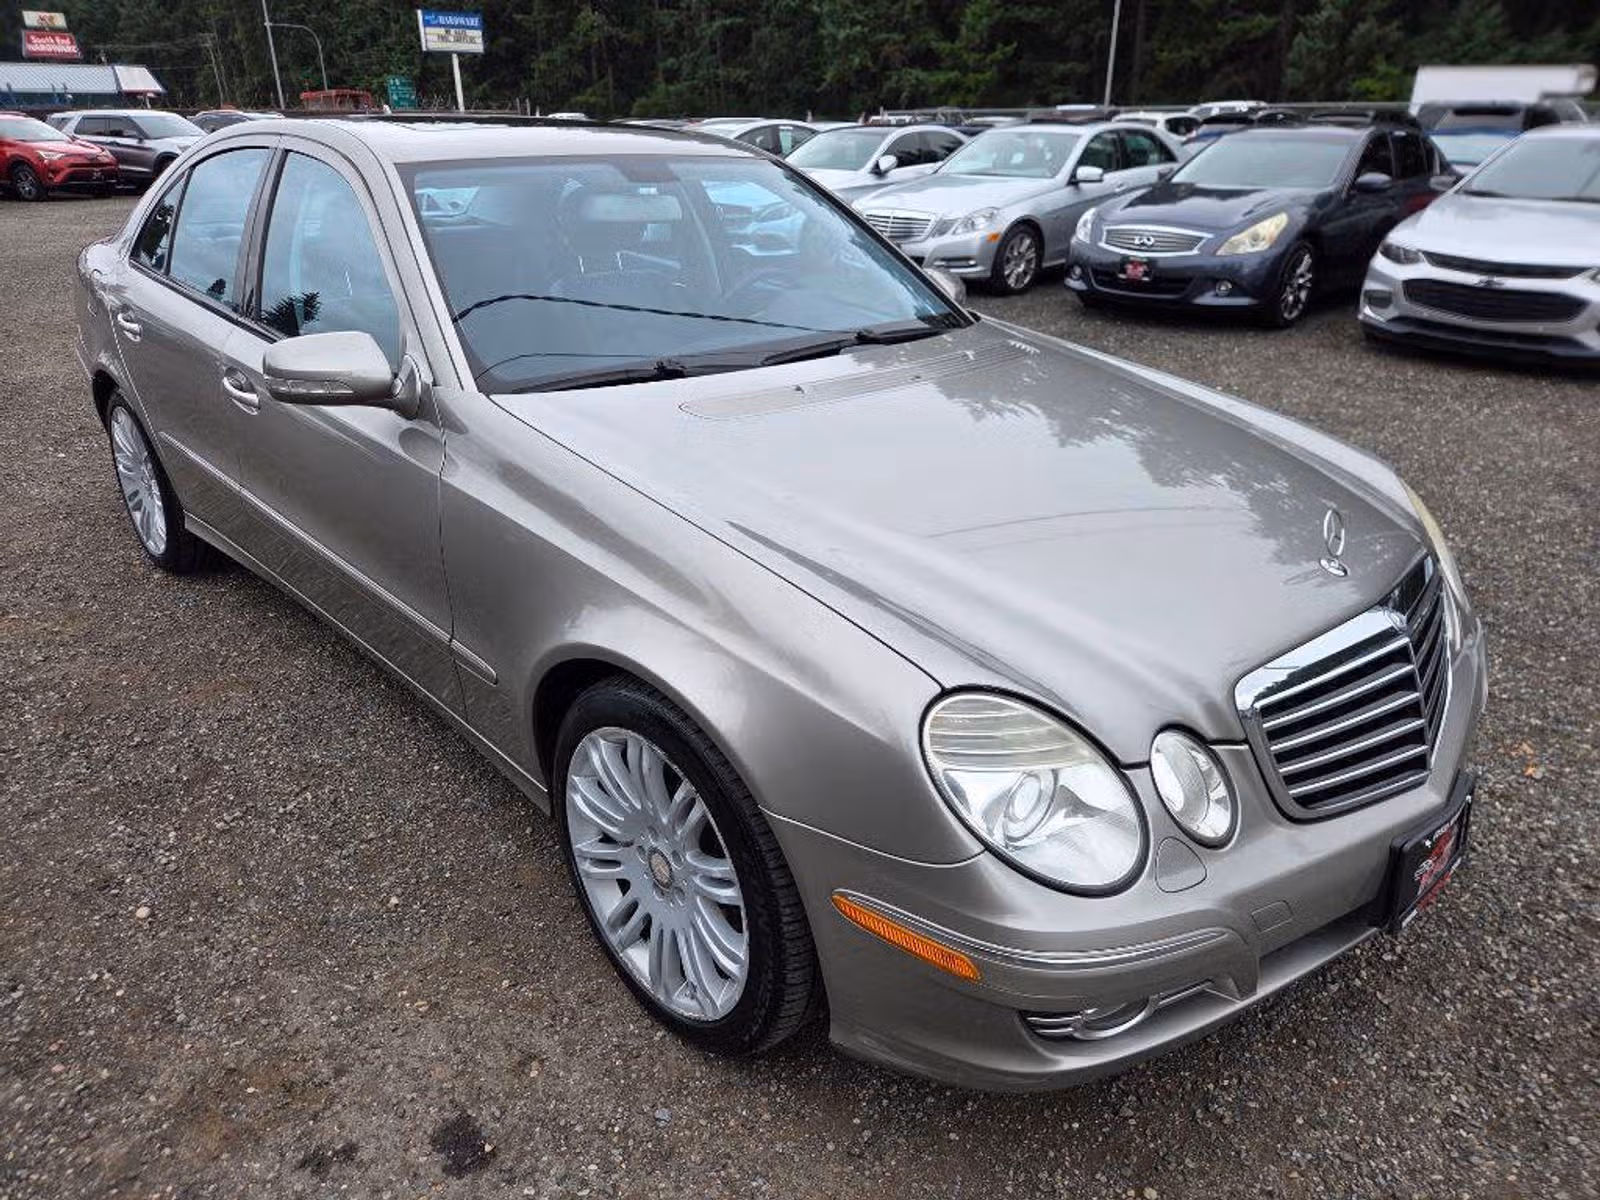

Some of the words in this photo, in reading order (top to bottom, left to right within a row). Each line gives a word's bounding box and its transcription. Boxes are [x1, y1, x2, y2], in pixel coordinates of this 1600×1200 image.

[438, 15, 480, 26] HARDWARE
[29, 35, 54, 44] South
[26, 43, 78, 53] HARDWARE
